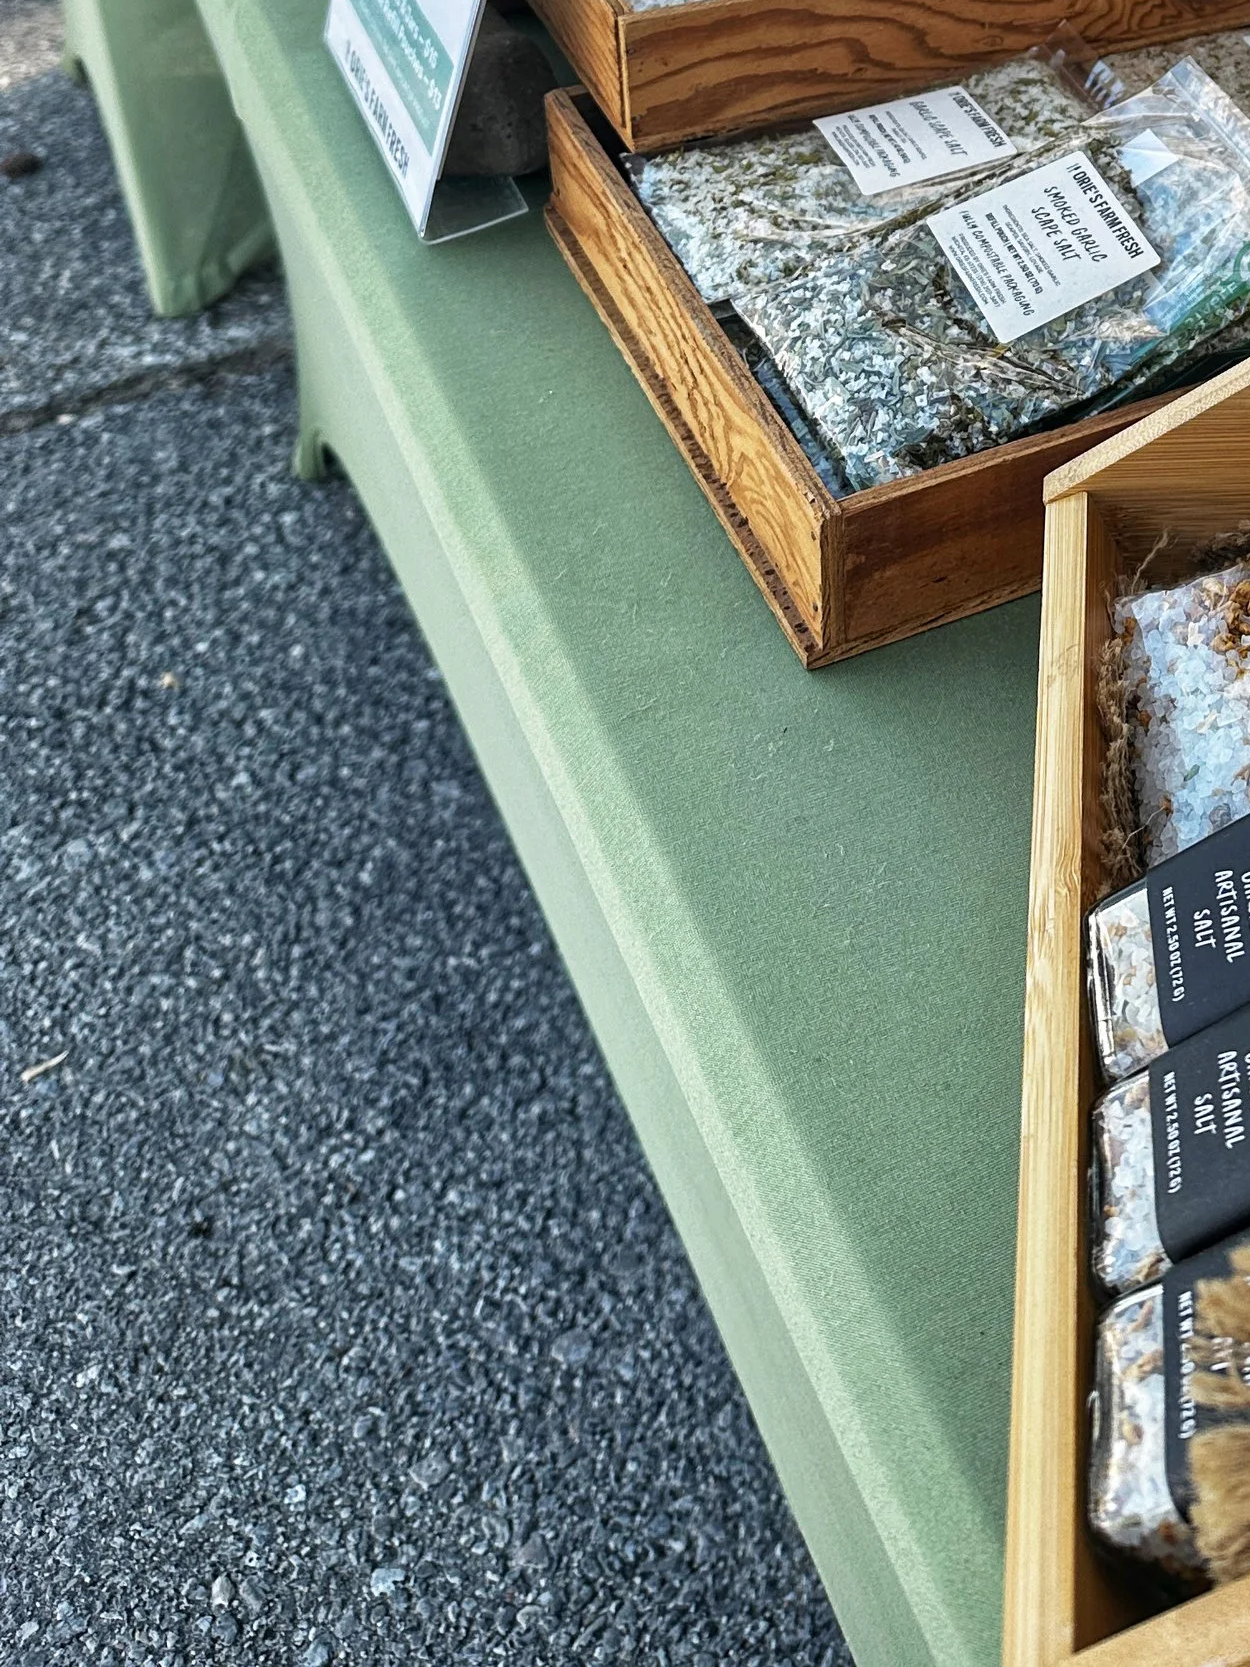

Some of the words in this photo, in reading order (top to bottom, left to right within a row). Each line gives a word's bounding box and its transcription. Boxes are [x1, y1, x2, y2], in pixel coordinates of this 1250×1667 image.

[1044, 186, 1081, 226] SMOKED
[1071, 227, 1108, 263] GARLIC
[1072, 171, 1104, 203] ORIE'S
[1094, 200, 1123, 230] FARM
[1111, 225, 1144, 259] FRESH
[1031, 206, 1062, 238] SCAPE
[1054, 238, 1081, 261] SALT
[972, 230, 1007, 274] COMPOSTABLE
[1002, 274, 1035, 316] PACKAGING
[1162, 886, 1175, 907] NET
[1164, 907, 1177, 925] WT
[1193, 908, 1217, 949] SALT
[1214, 869, 1247, 963] ARTISANAL
[1166, 924, 1179, 952] 2.50
[1169, 950, 1182, 967] OZ
[1169, 967, 1184, 988] (72
[1172, 986, 1185, 1002] G)
[1163, 1071, 1176, 1094] NET
[1165, 1092, 1178, 1112] WT
[1217, 1049, 1247, 1150] ARTISANAL
[1166, 1111, 1180, 1141] 2.50
[1194, 1093, 1217, 1135] SALT
[1167, 1139, 1181, 1157] OZ
[1166, 1155, 1182, 1178] (72
[1167, 1176, 1182, 1194] G)
